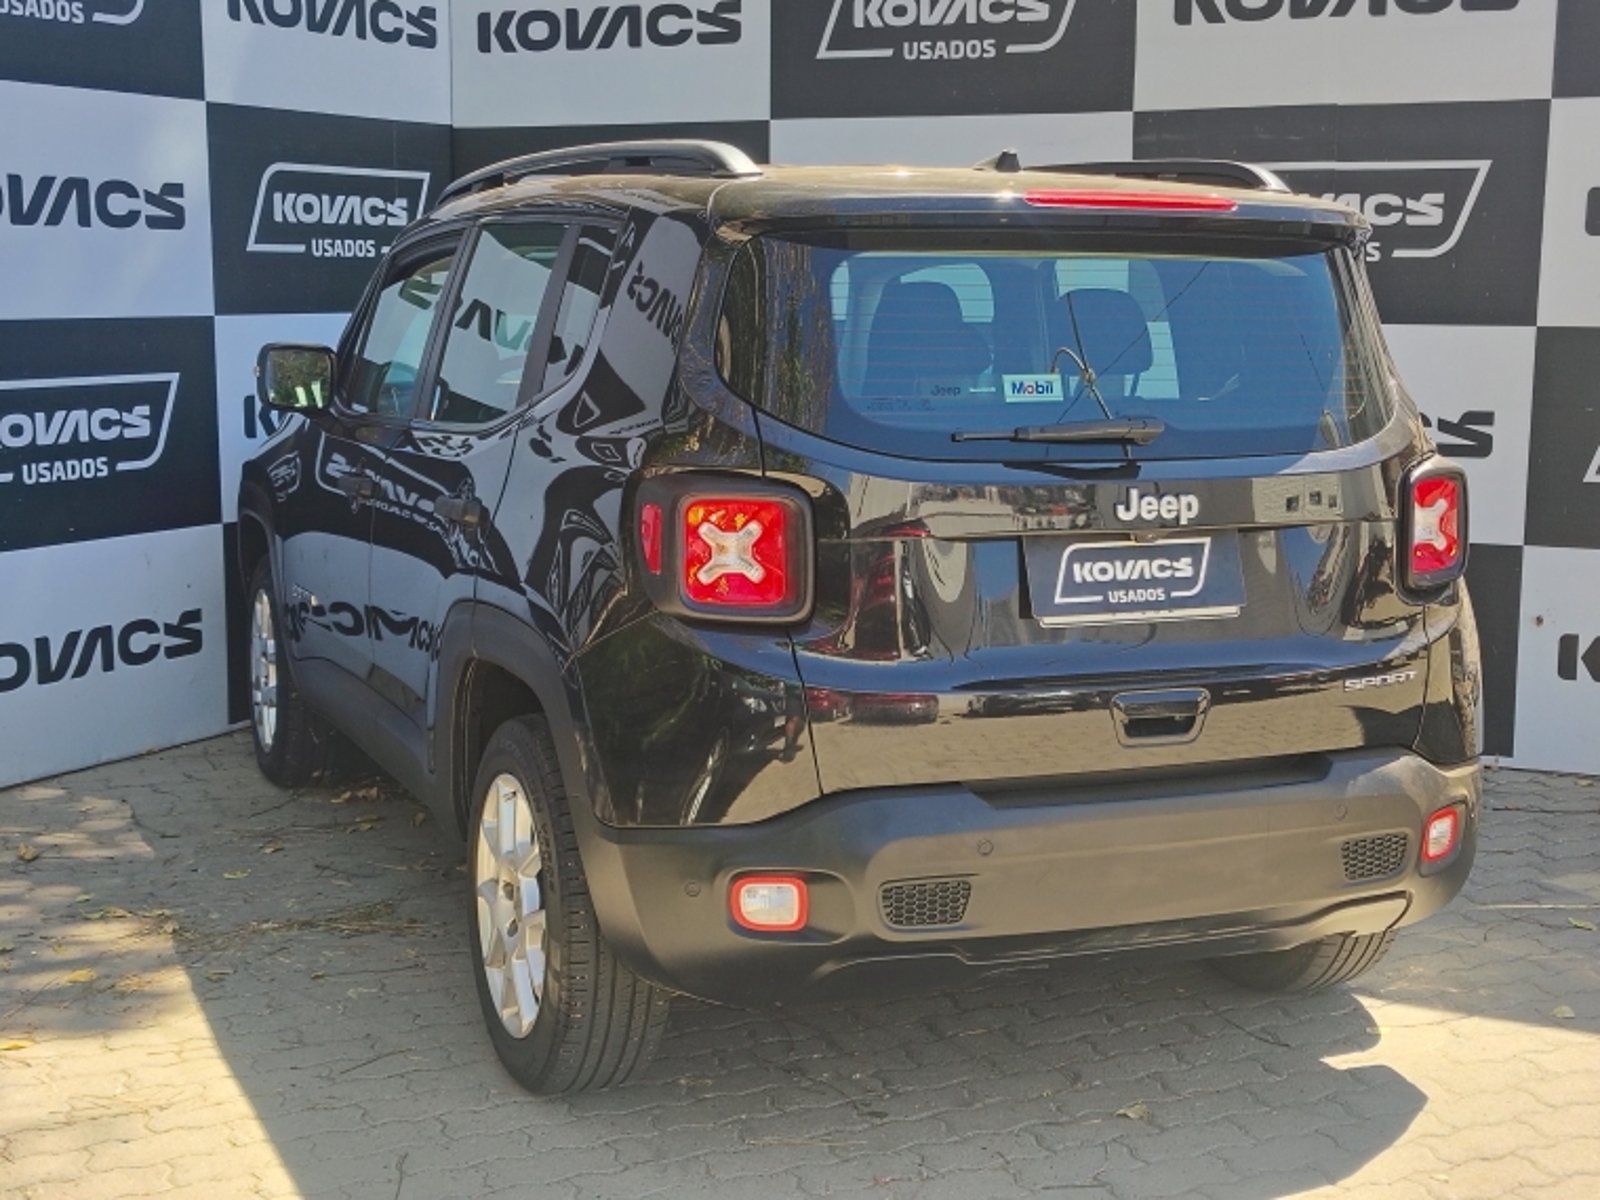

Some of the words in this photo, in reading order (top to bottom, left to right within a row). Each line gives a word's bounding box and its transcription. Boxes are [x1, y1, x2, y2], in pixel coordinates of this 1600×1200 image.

[477, 0, 742, 53] KOVACS
[853, 0, 1050, 28] KOVACS
[903, 39, 996, 60] USADOS
[0, 173, 186, 230] VACS
[273, 191, 408, 226] KOVACS
[311, 238, 375, 257] USADOS
[1011, 380, 1054, 395] Mobil
[0, 405, 151, 449] OVACS
[22, 457, 109, 485] USADOS
[1116, 488, 1199, 525] Jeep
[1073, 557, 1194, 584] KOVACS
[1108, 588, 1165, 604] USADOS
[1344, 671, 1417, 692] SPORT
